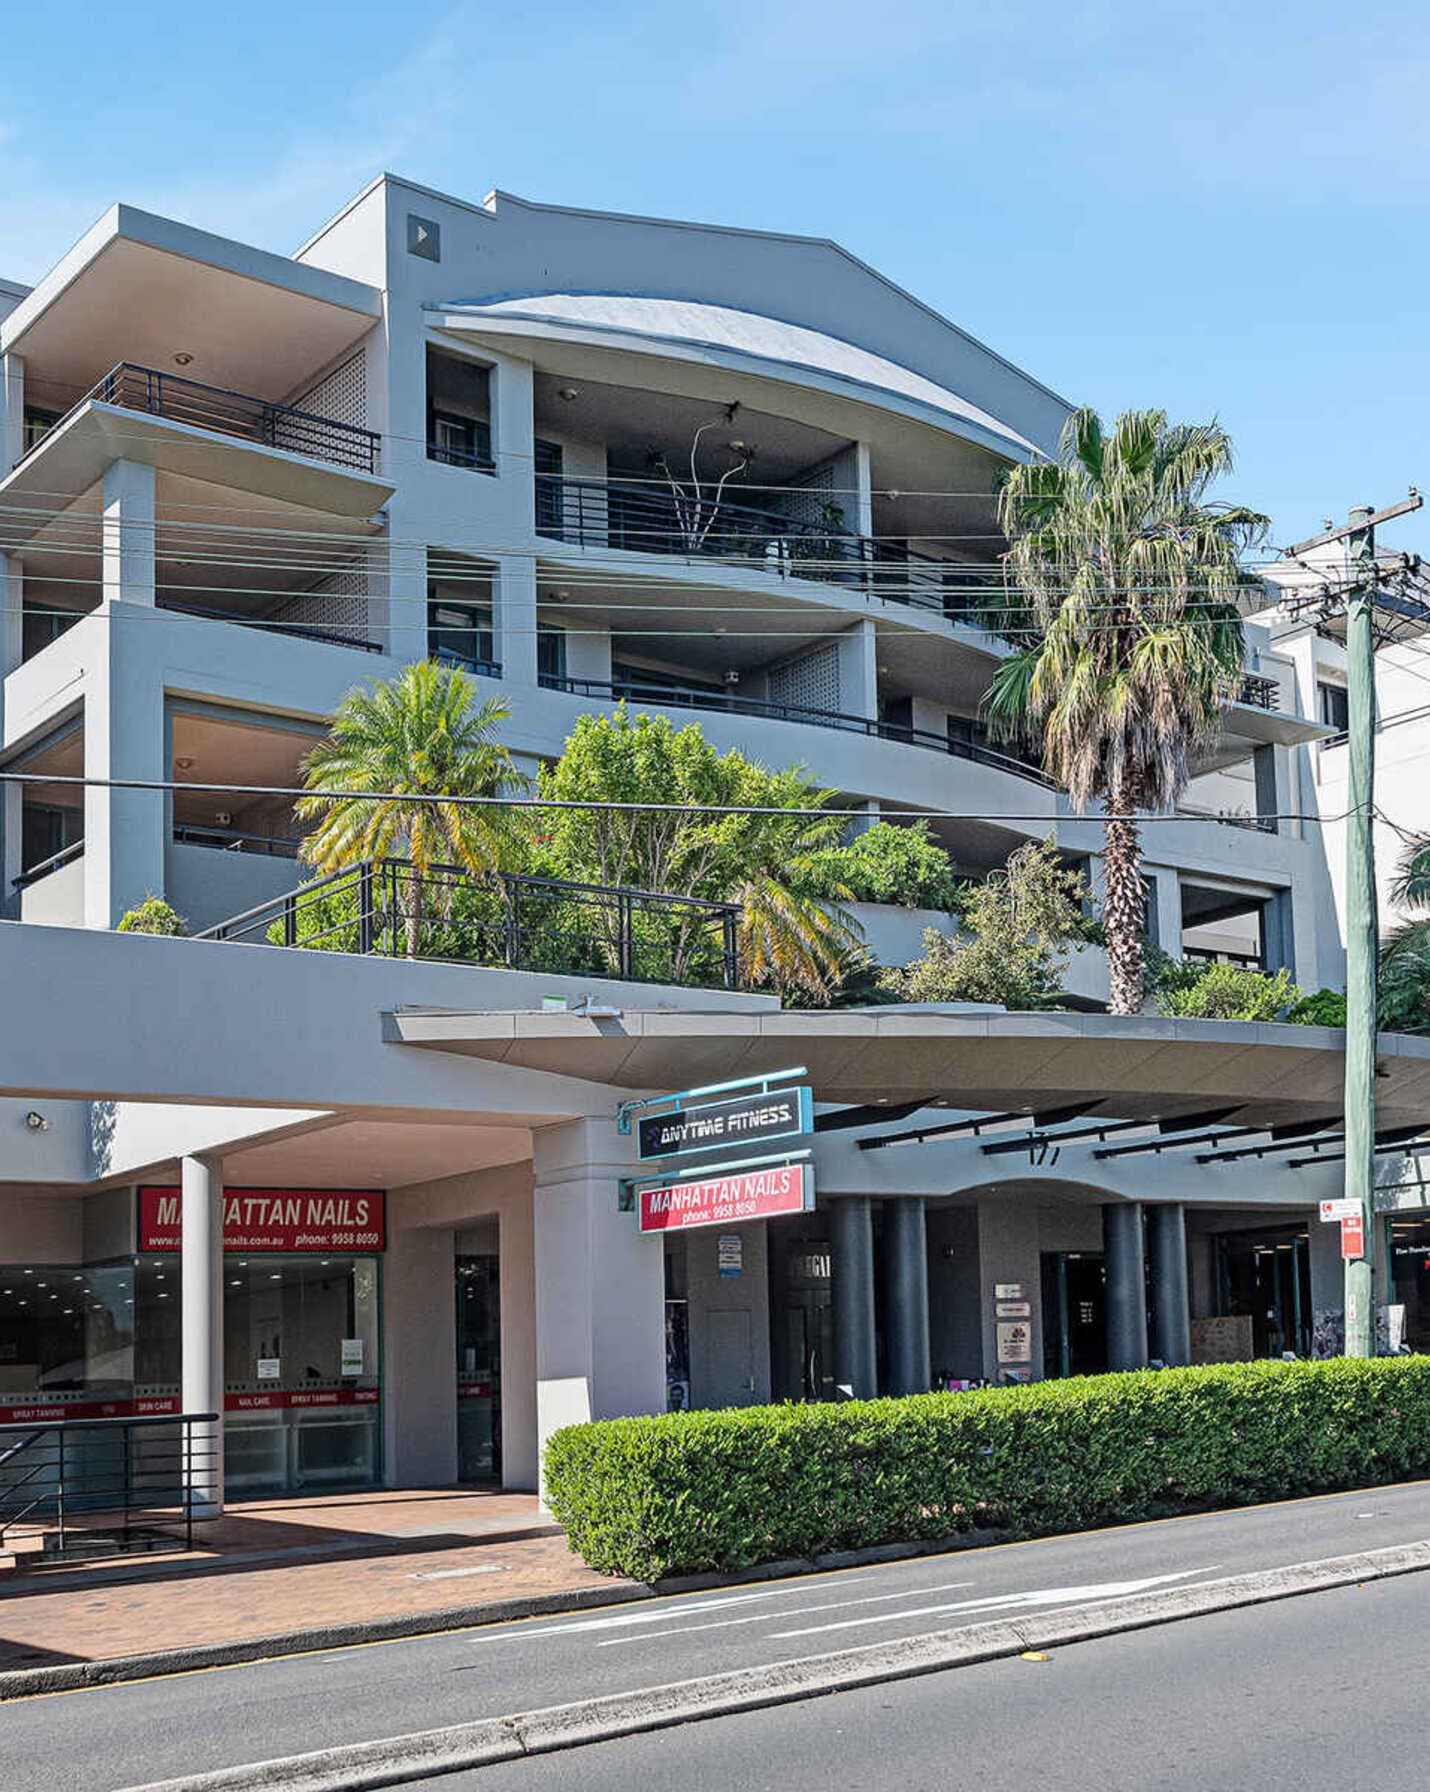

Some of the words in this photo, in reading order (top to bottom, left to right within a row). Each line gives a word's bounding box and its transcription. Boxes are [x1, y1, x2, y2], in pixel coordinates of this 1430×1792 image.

[660, 1116, 725, 1145] ANYTIME
[727, 1103, 792, 1132] FITNESS
[1026, 1131, 1060, 1166] 177
[650, 1182, 741, 1215] MANHATTAN
[743, 1171, 792, 1198] NAILS
[157, 1197, 301, 1226] MATTAN
[306, 1198, 369, 1227] NAILS
[295, 1233, 329, 1247] phone:
